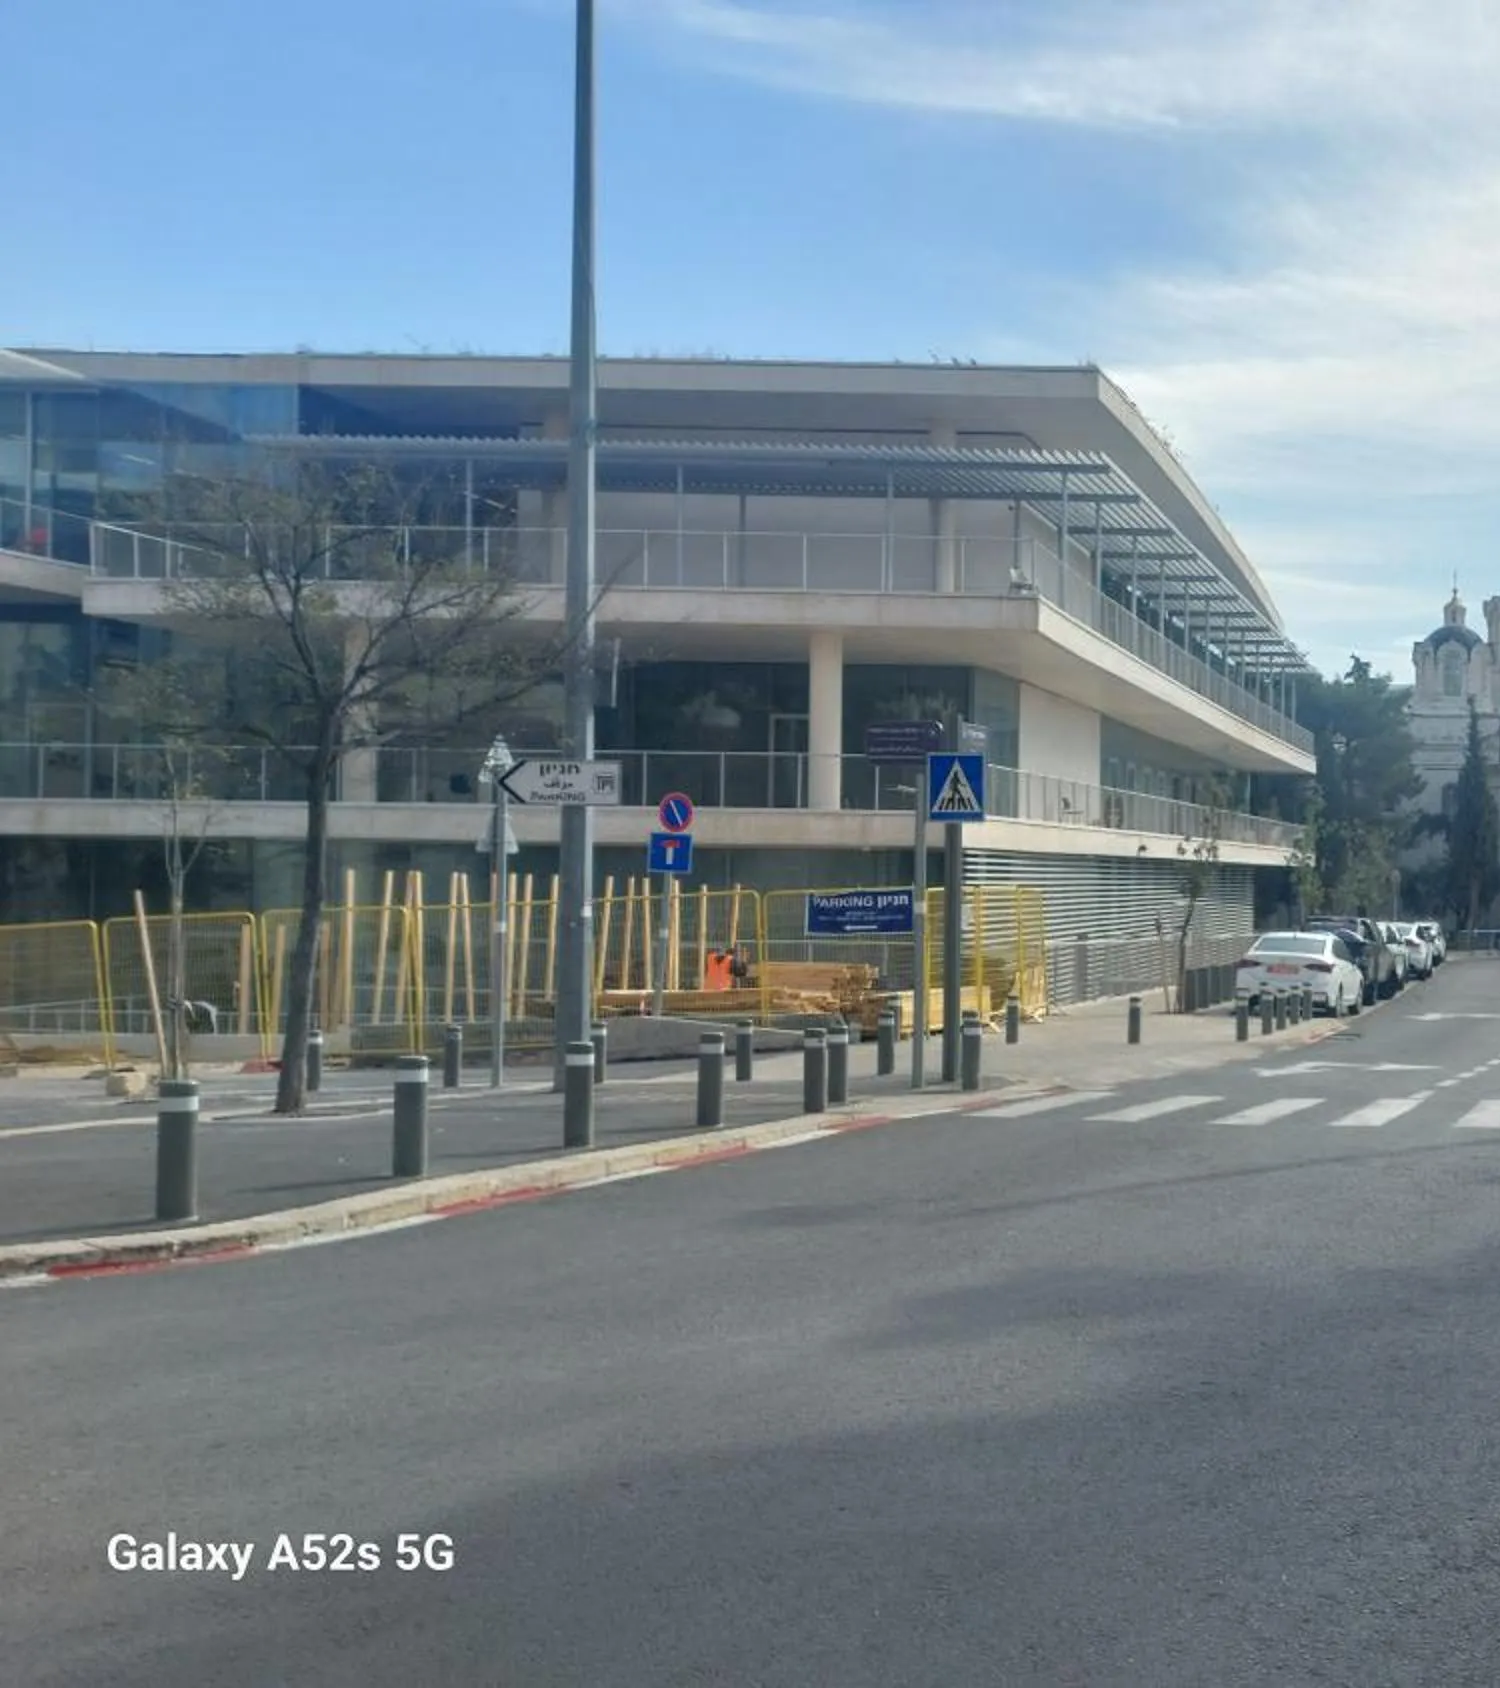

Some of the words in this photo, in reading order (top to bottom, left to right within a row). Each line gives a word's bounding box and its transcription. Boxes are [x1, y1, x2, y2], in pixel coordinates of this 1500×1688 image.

[539, 763, 581, 777] חניון
[813, 895, 874, 909] PARKING
[877, 894, 909, 909] חניון
